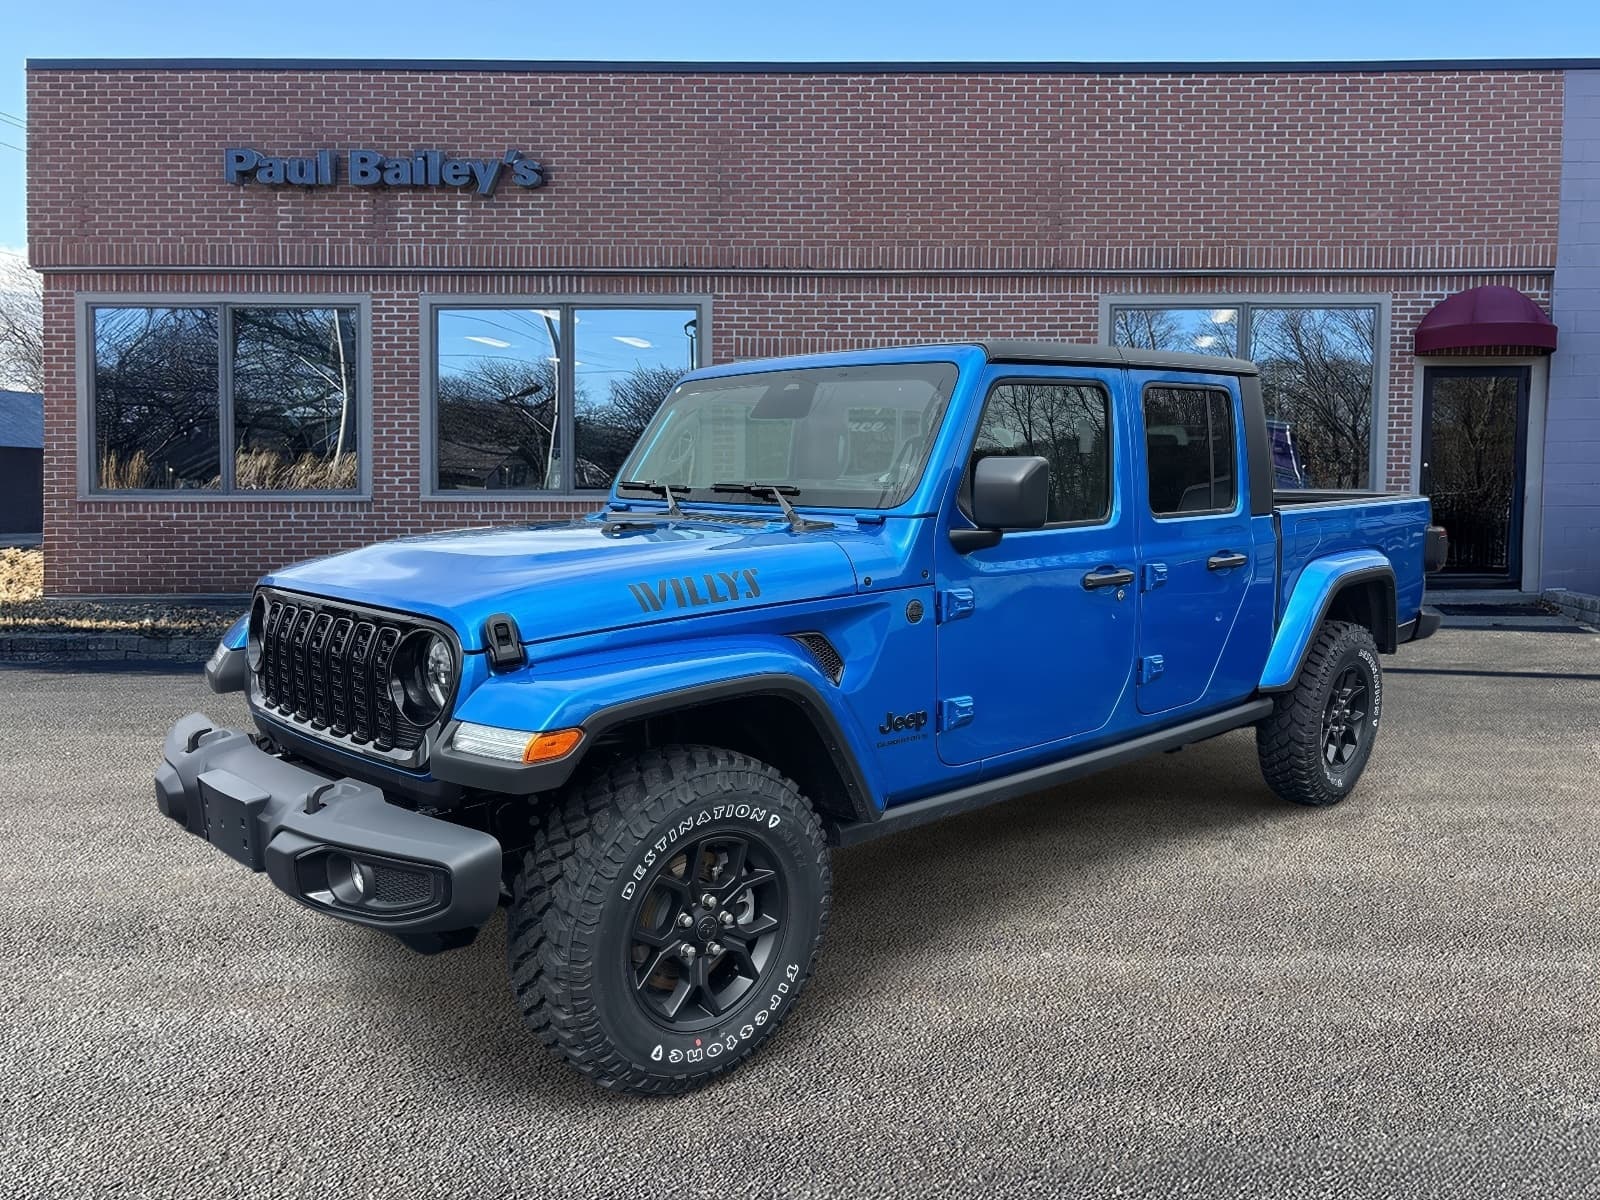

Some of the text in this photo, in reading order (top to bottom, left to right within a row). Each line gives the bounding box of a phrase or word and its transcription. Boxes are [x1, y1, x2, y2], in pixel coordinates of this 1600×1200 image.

[224, 148, 548, 198] Paul Bailey's
[627, 567, 761, 613] WILLYS
[879, 710, 928, 735] Jeep
[621, 804, 767, 900] DESTINATION
[668, 964, 799, 1063] Firestone
